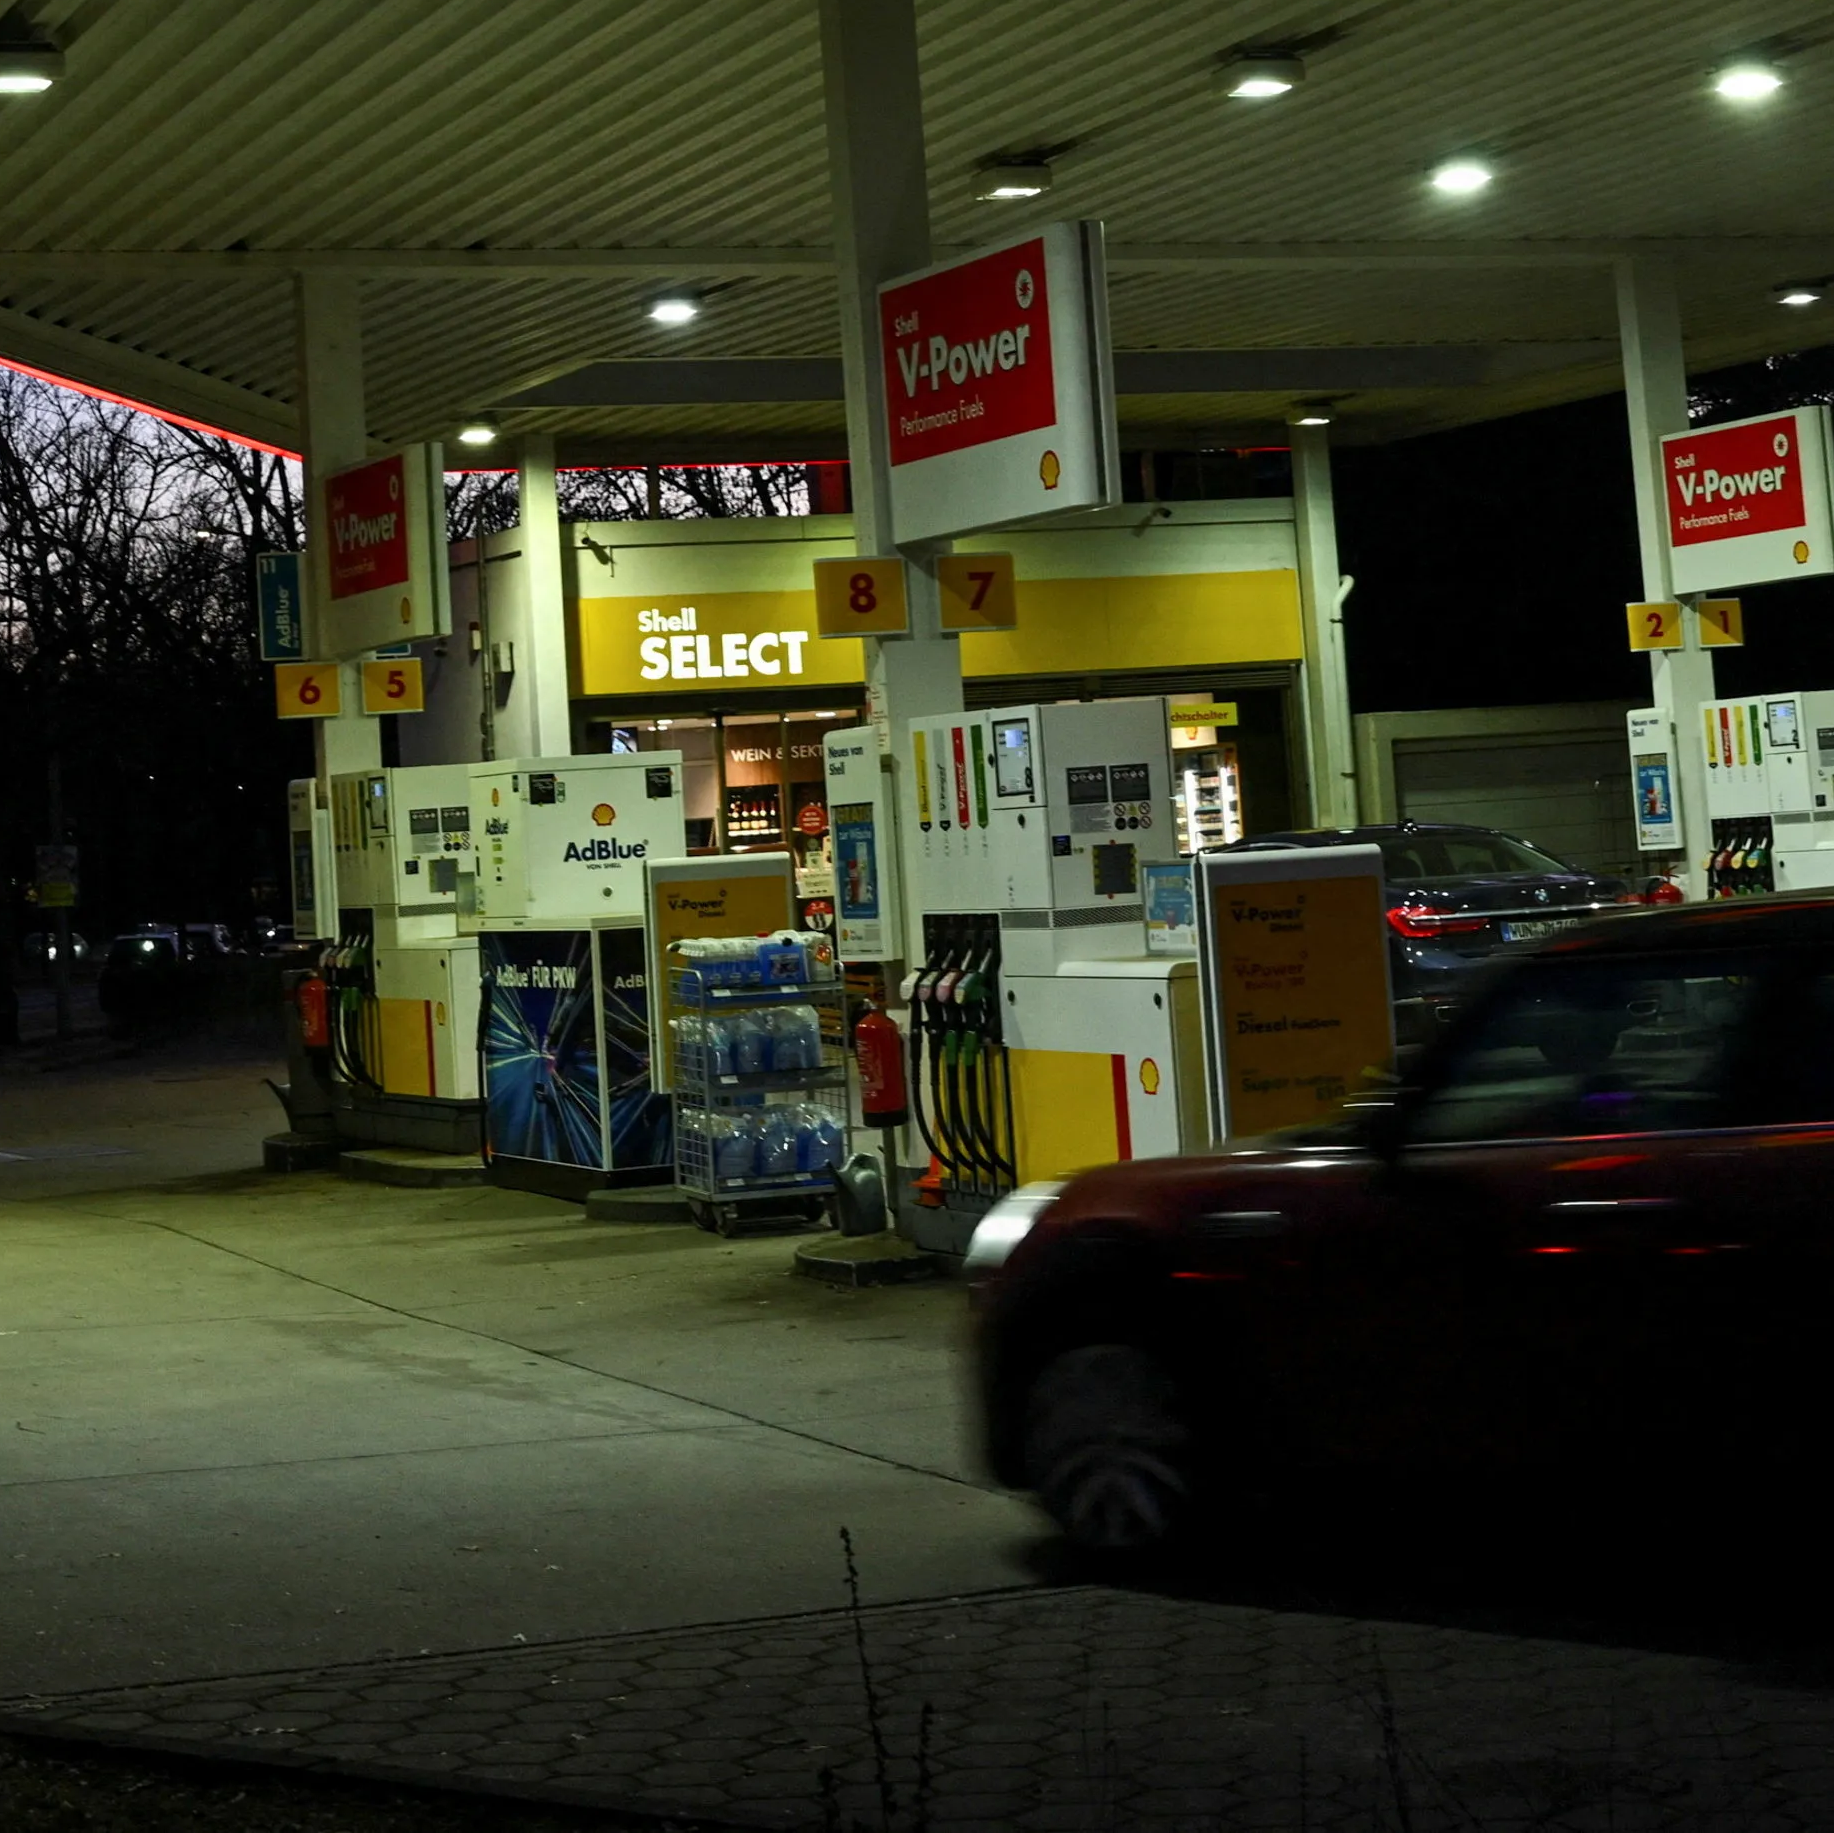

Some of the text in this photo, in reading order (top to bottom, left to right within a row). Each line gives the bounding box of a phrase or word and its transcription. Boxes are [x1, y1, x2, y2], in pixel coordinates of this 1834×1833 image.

[894, 310, 919, 337] Shell
[896, 323, 1030, 398] V-Power
[900, 393, 985, 437] Performance Fuels
[1674, 454, 1695, 469] Shell
[1676, 465, 1786, 507] V-Power
[334, 511, 397, 554] V-Power
[849, 573, 876, 613] 8
[968, 572, 995, 610] 7
[638, 607, 697, 632] Shell
[1646, 613, 1664, 637] 2
[1719, 610, 1729, 634] 1
[640, 631, 808, 680] SELECT
[299, 676, 321, 704] 6
[386, 670, 406, 698] 5
[1170, 710, 1229, 722] chtschalter
[731, 748, 771, 763] WEIN
[790, 744, 824, 759] SEKT
[668, 899, 723, 910] V-Power
[1232, 907, 1303, 922] V-Power
[552, 966, 576, 989] PKW
[614, 974, 645, 989] AdB
[1233, 964, 1304, 978] V-Power
[1237, 1016, 1287, 1034] Diesel
